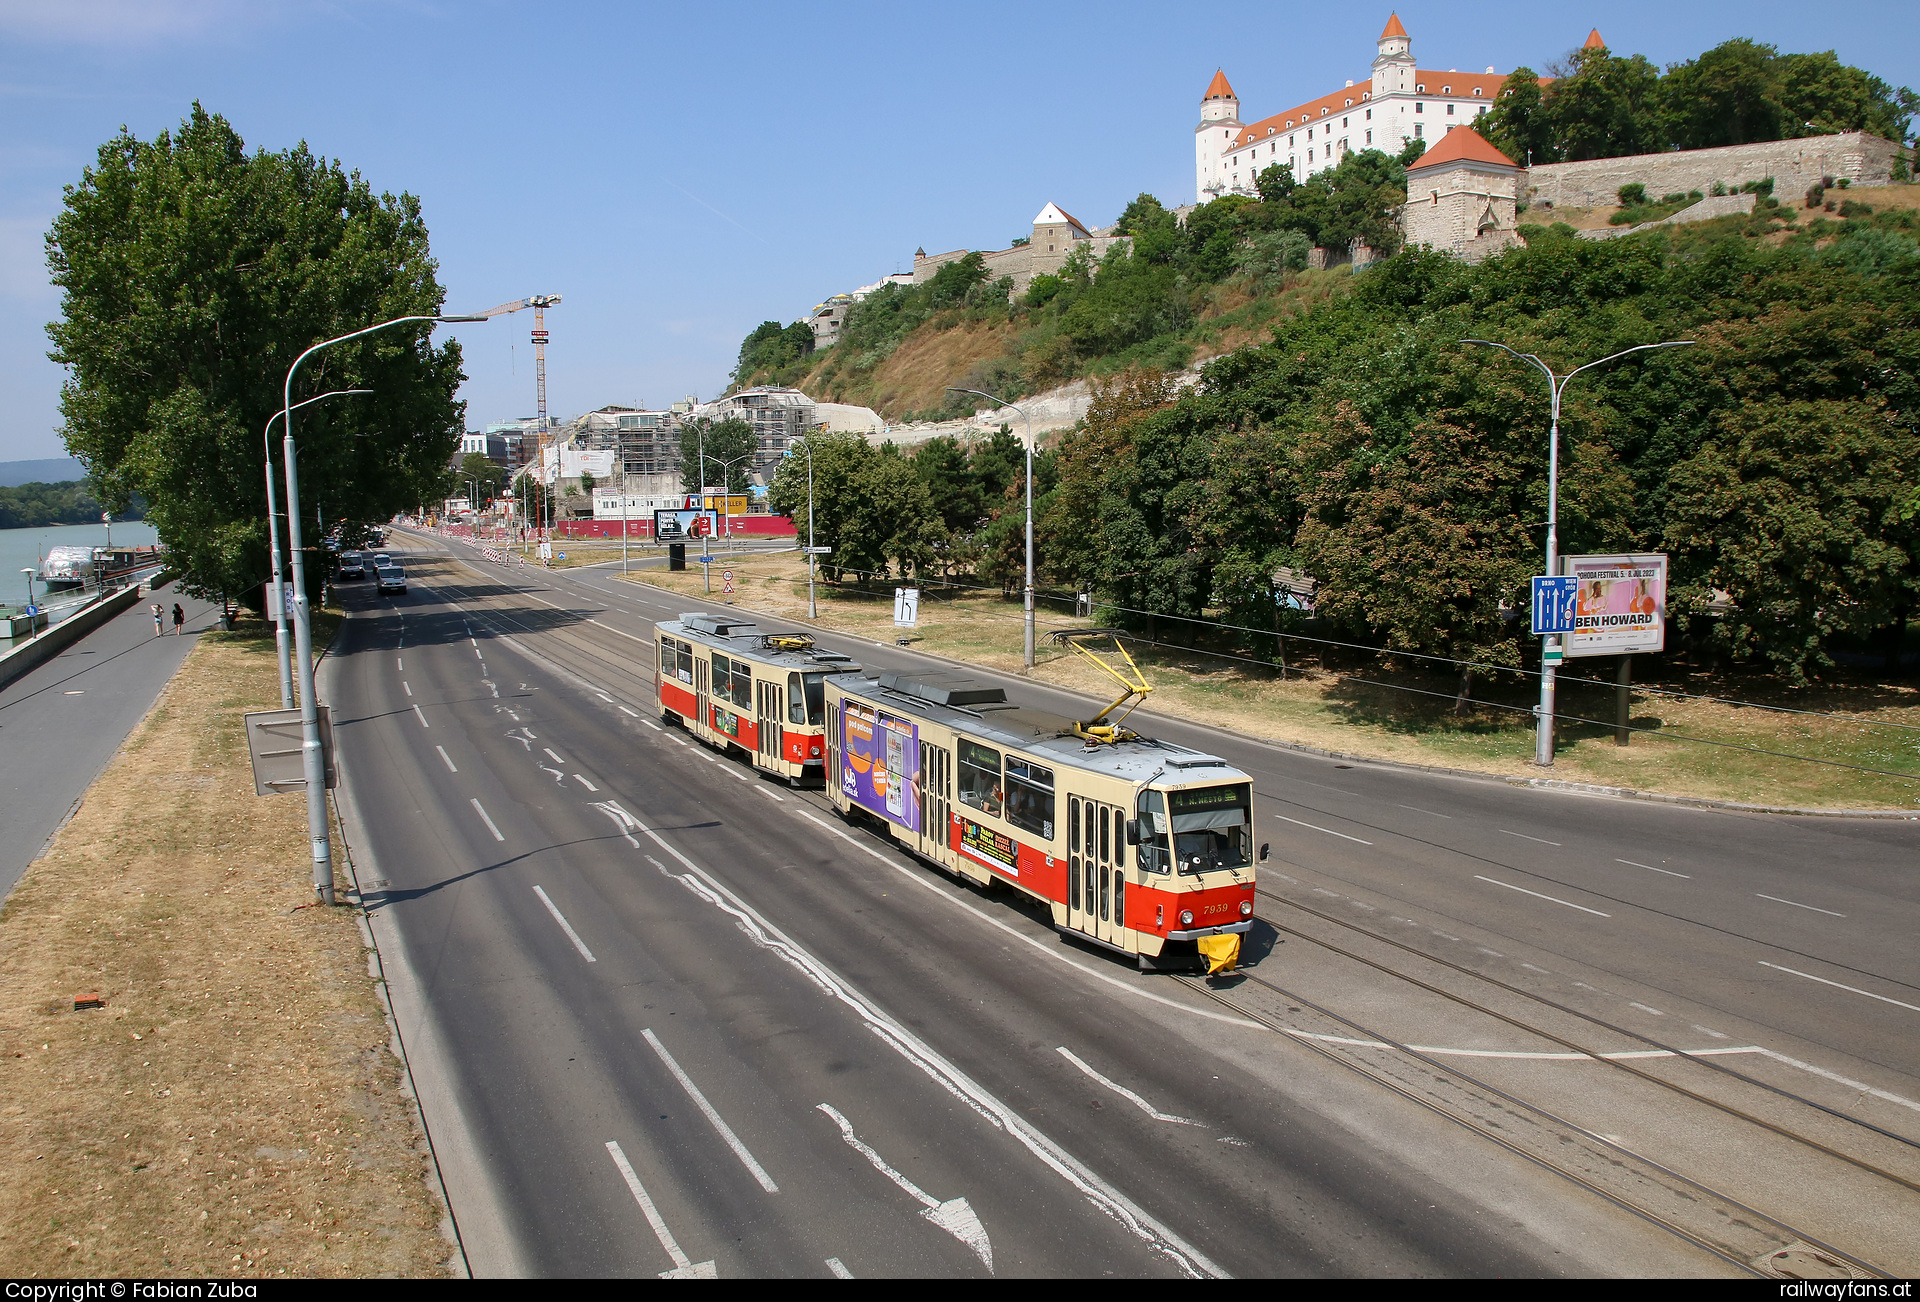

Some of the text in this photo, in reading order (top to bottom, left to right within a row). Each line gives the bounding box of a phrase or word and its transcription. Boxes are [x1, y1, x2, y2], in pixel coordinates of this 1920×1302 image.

[1598, 571, 1620, 579] FESTIVAL
[1575, 613, 1652, 627] BEN HOWARD
[848, 720, 873, 735] pod palcom
[971, 746, 975, 758] 4
[1175, 793, 1183, 806] 4
[1203, 903, 1229, 915] 7939
